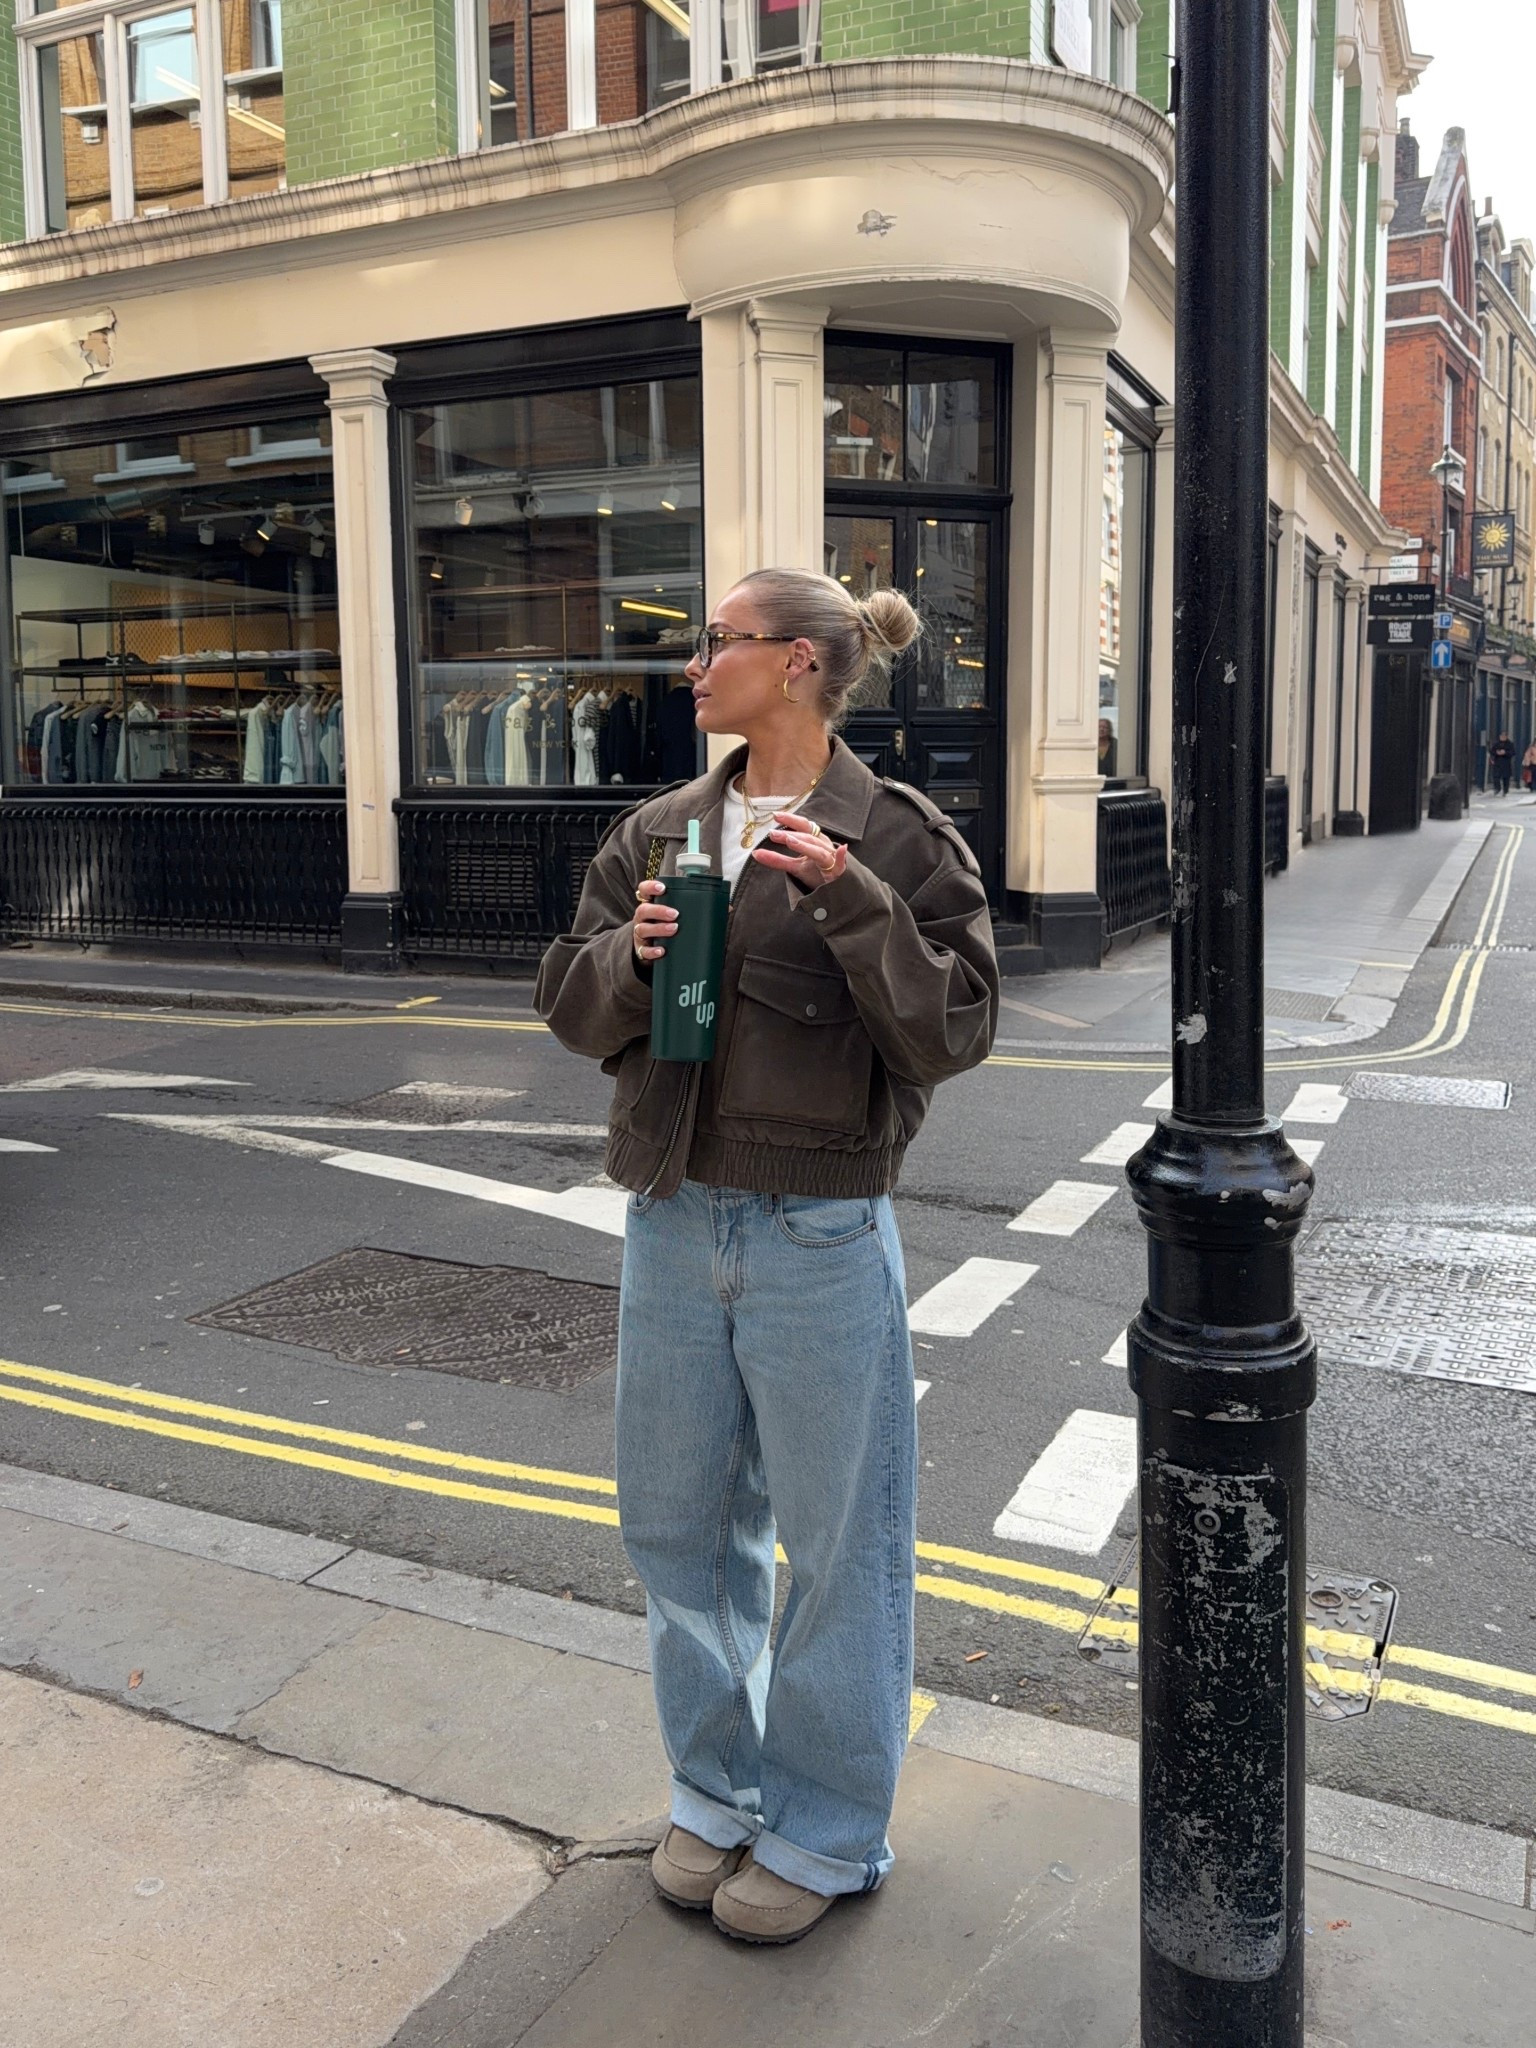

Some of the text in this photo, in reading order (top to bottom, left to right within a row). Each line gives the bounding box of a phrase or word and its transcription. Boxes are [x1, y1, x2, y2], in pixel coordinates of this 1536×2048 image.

[1374, 592, 1431, 602] rag & bone
[1443, 615, 1450, 626] P
[1389, 630, 1412, 639] TRADE
[678, 980, 707, 1007] air
[696, 1001, 715, 1029] up
